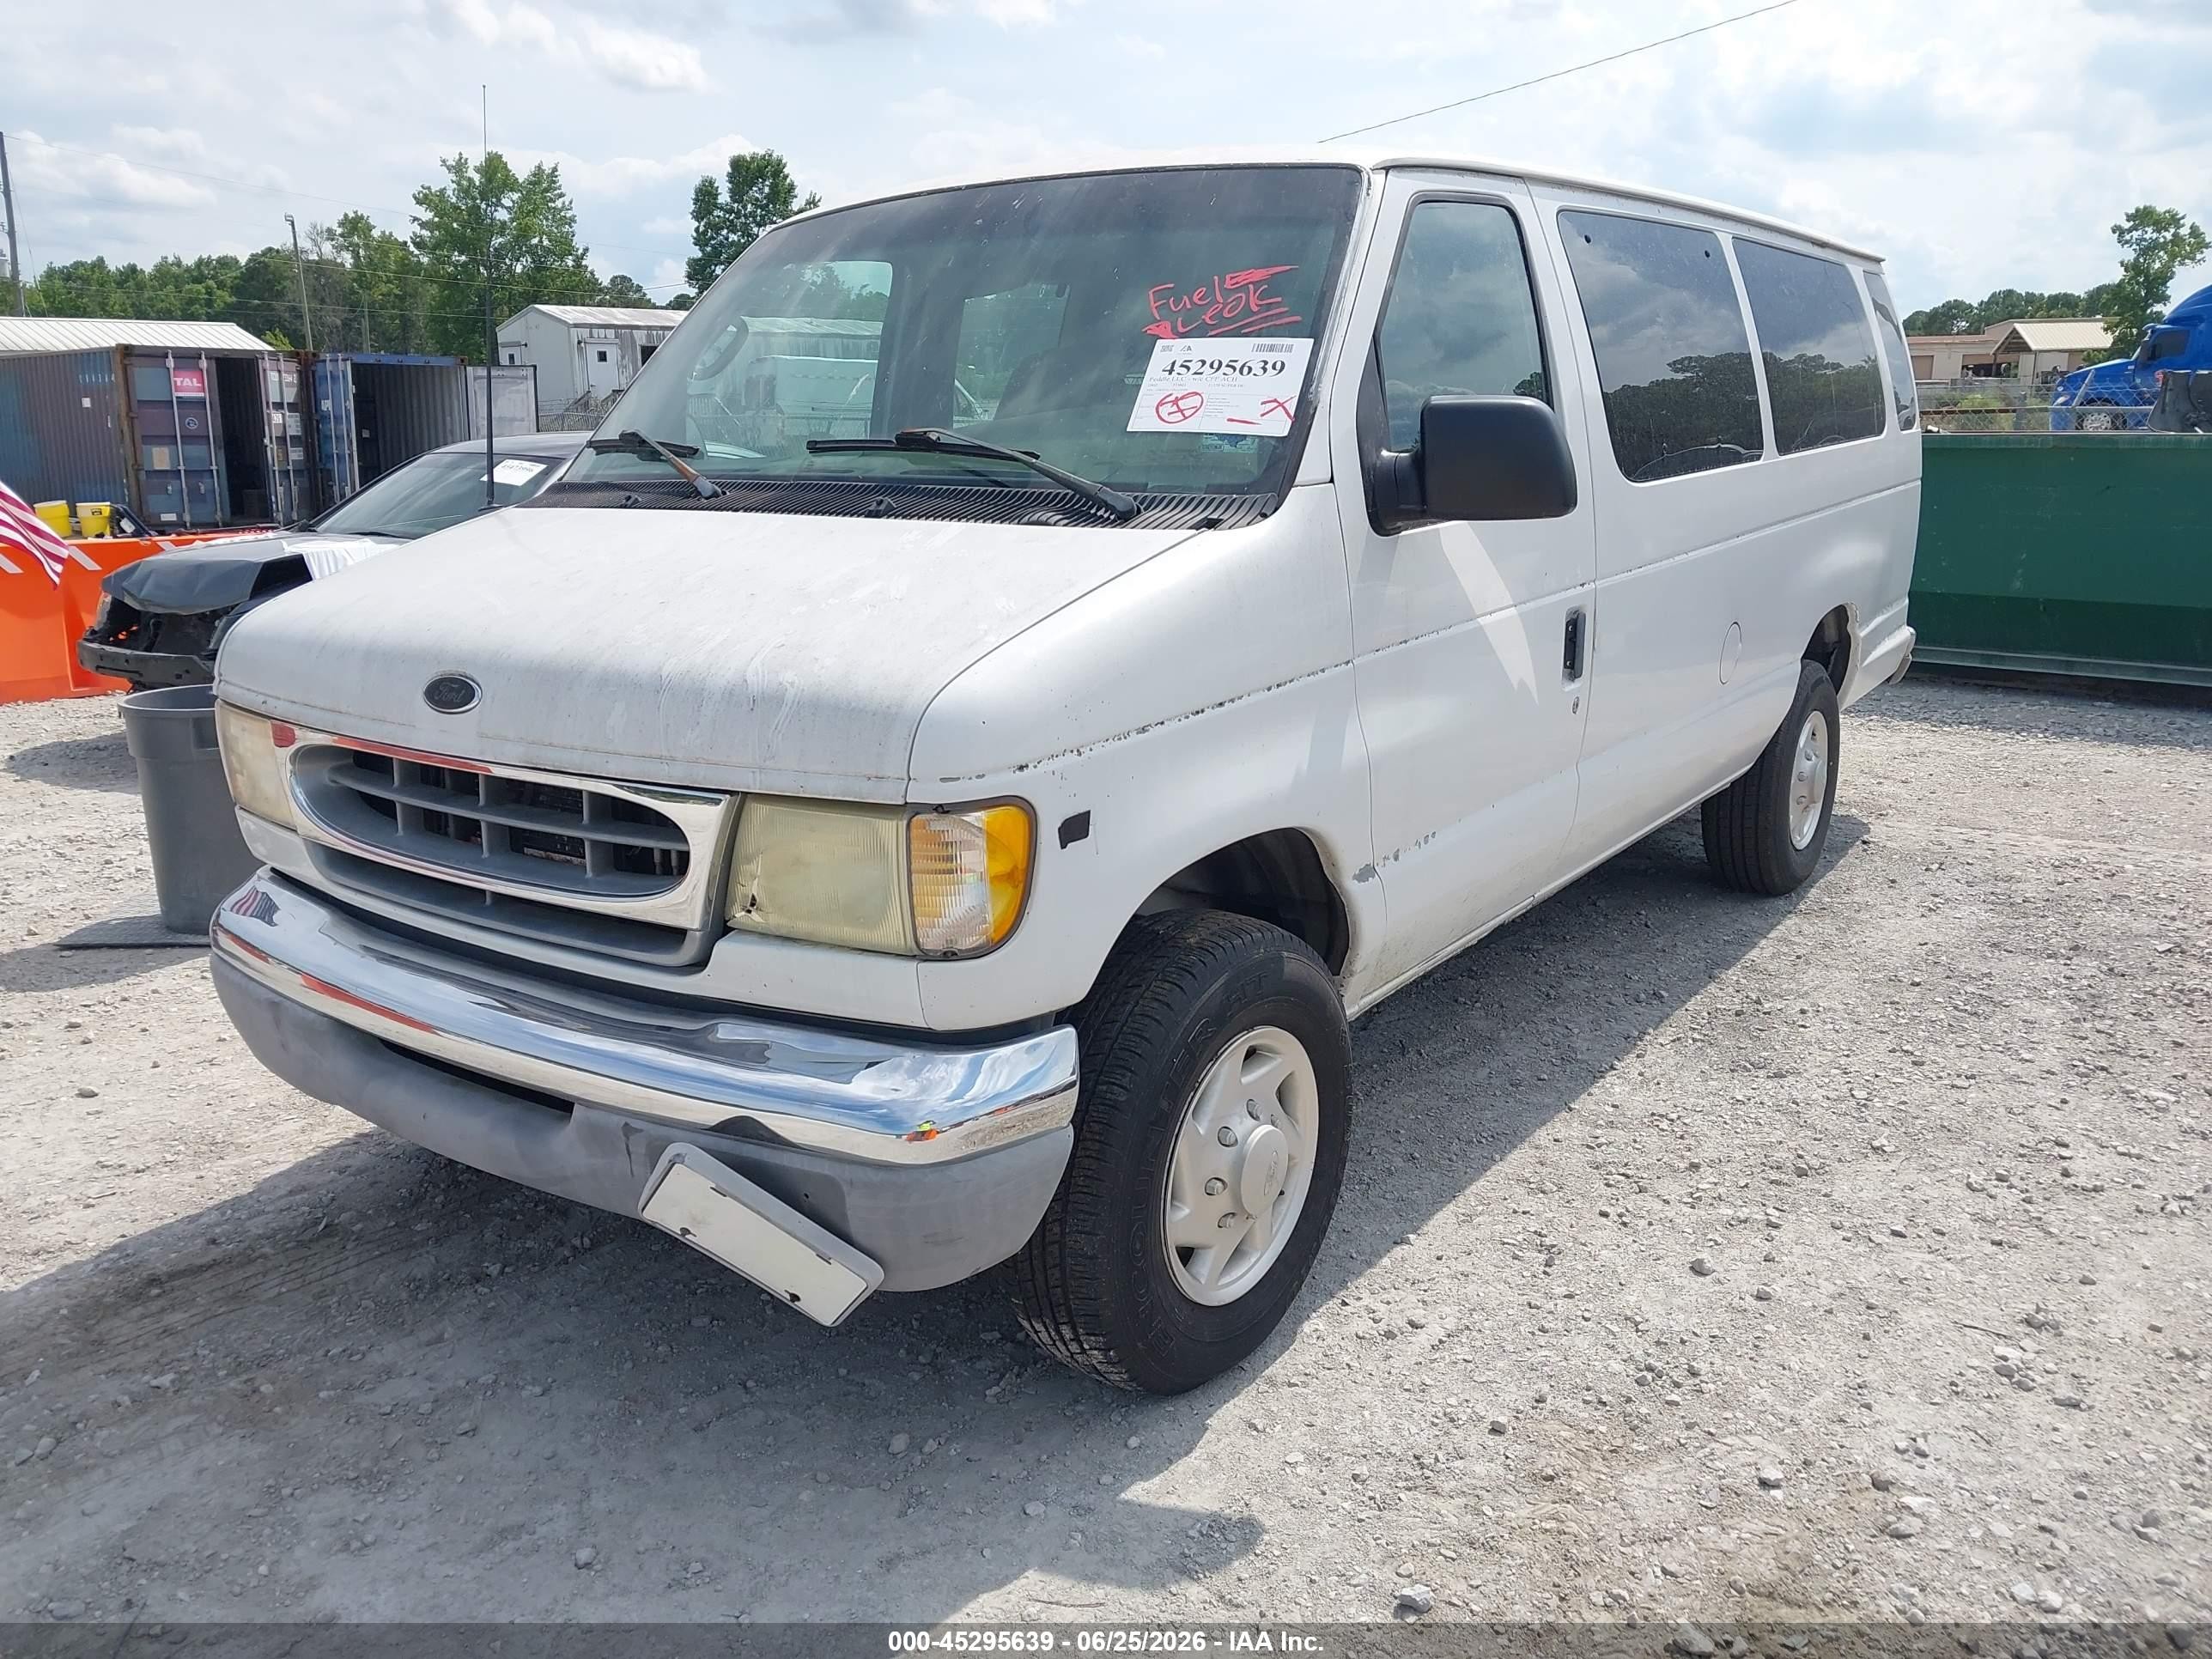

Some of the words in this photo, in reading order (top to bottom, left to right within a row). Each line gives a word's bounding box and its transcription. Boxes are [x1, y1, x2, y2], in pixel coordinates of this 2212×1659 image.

[1148, 276, 1224, 320] Fuel
[1162, 359, 1285, 377] 45295639
[173, 377, 202, 386] TAL
[434, 681, 465, 703] Ford
